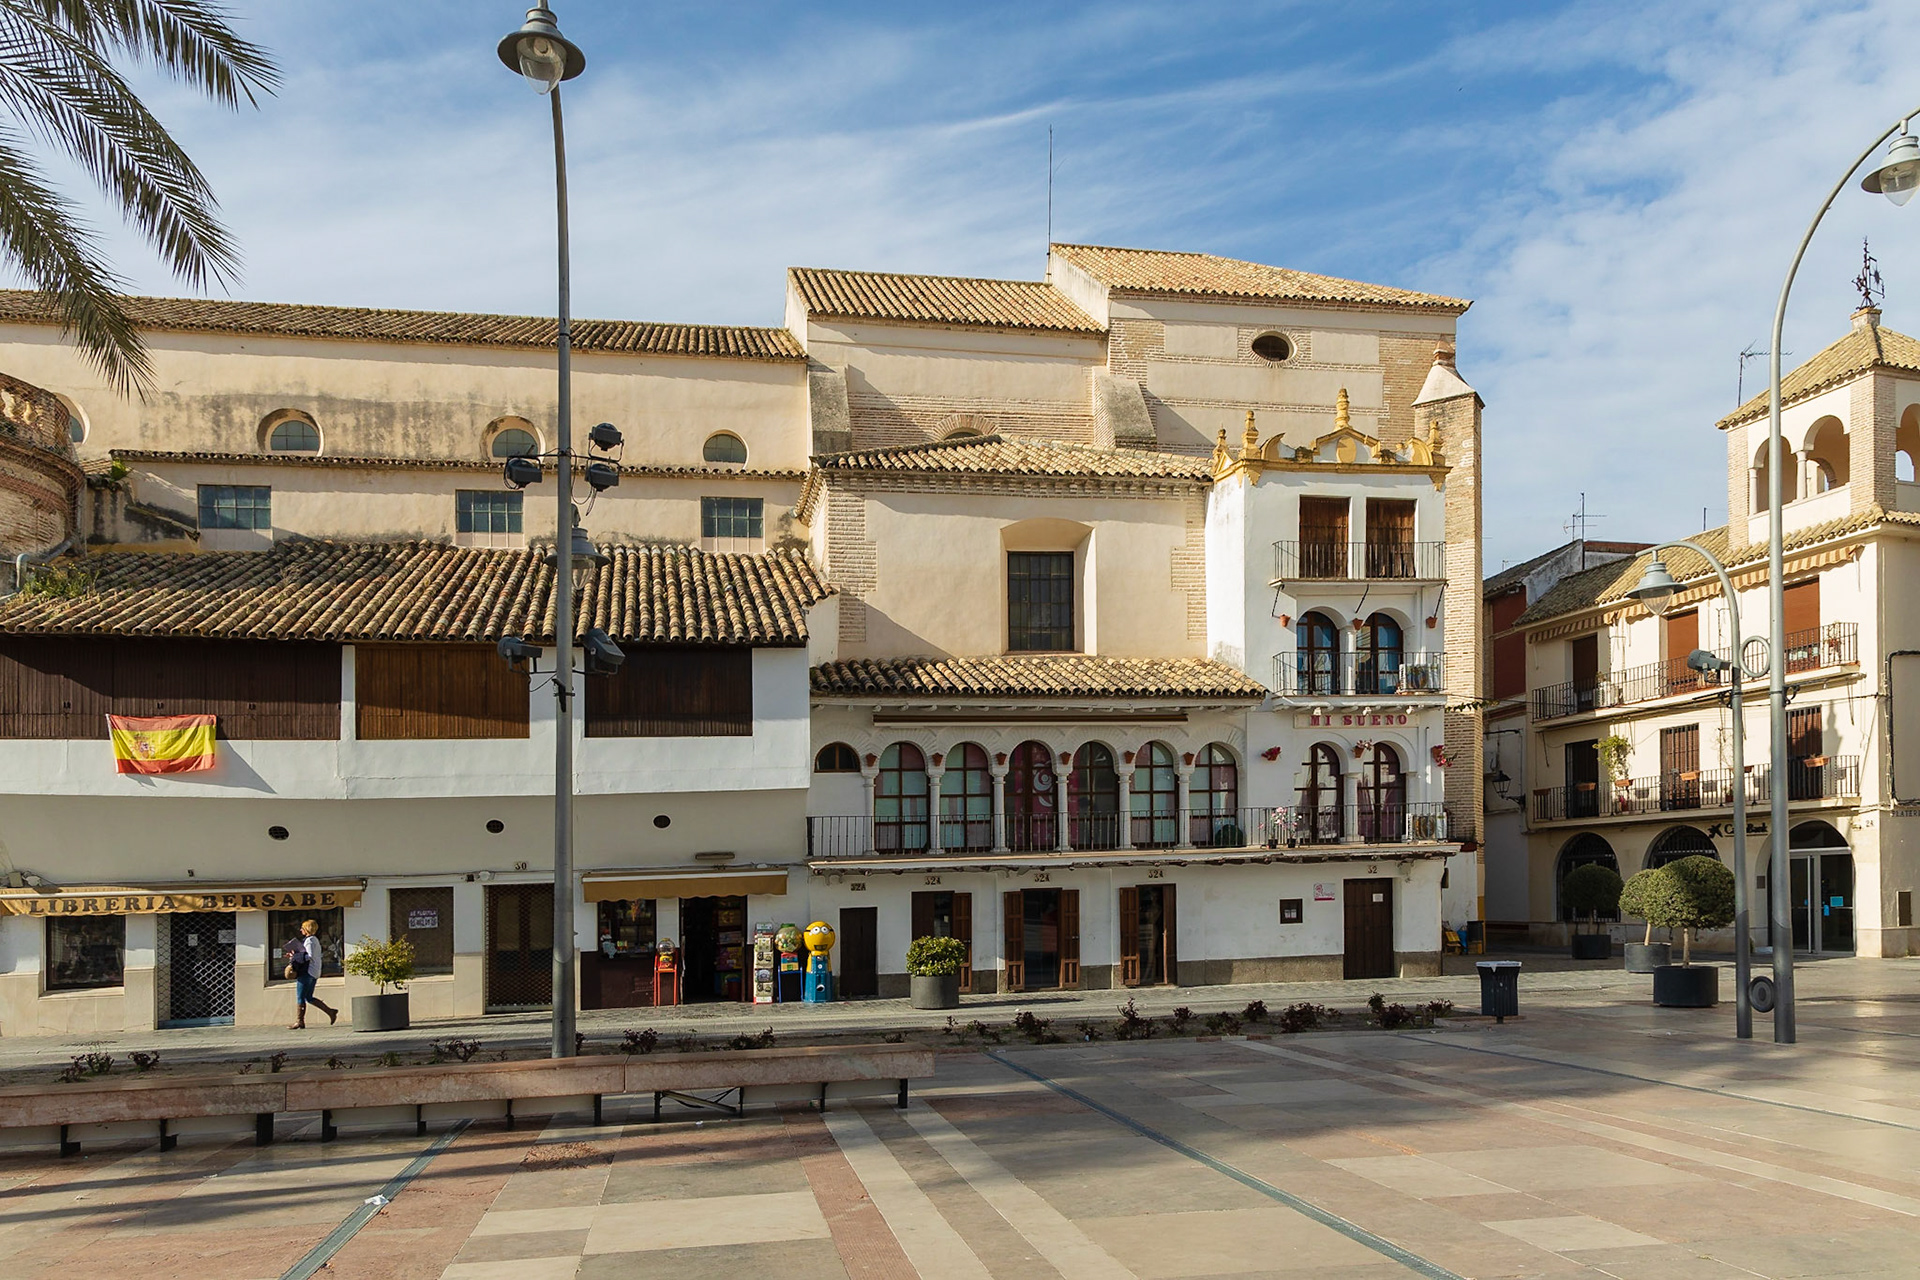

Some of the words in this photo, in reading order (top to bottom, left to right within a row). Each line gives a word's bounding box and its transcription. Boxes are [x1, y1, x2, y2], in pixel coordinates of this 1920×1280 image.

[1310, 715, 1331, 726] MI
[1367, 865, 1378, 874] 32
[850, 883, 867, 892] 32A
[29, 896, 177, 913] LIBRERIA
[201, 893, 335, 909] BERSABE
